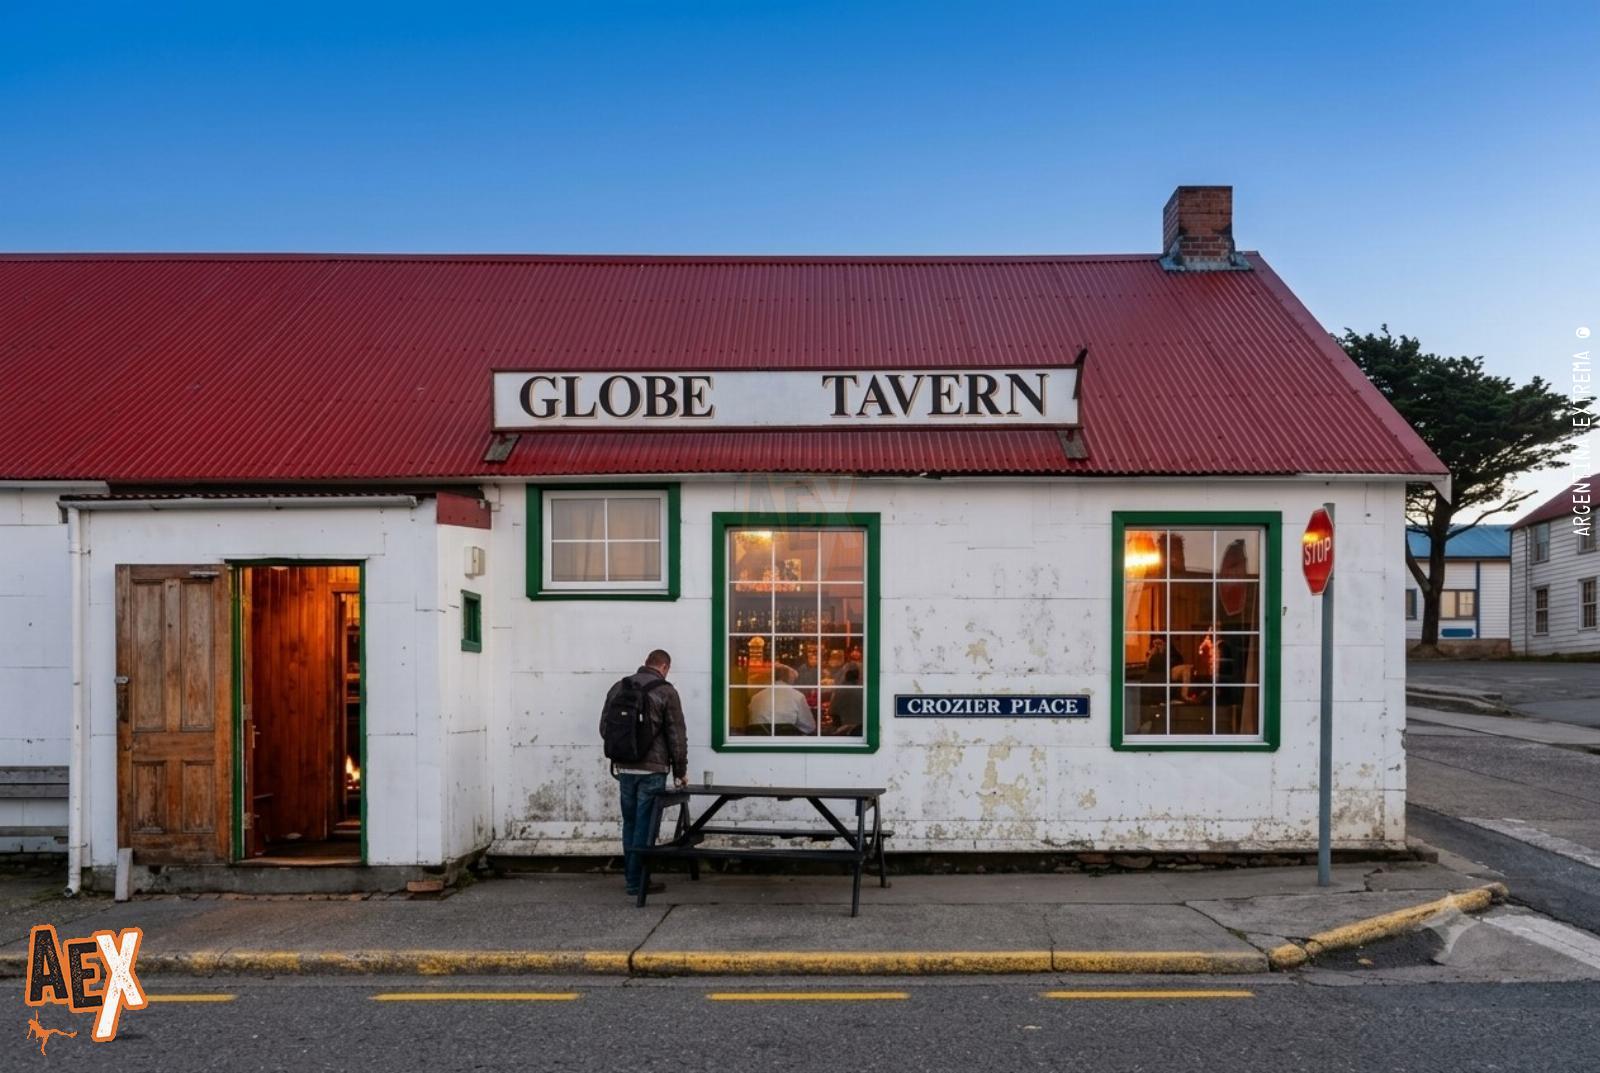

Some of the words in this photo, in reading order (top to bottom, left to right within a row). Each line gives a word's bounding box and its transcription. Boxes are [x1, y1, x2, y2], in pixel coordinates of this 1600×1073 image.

[519, 374, 715, 419] GLOBE
[821, 372, 1049, 417] TAVERN
[1304, 536, 1332, 566] STOP
[907, 698, 1001, 714] CROZIER
[1010, 698, 1079, 714] PLACE
